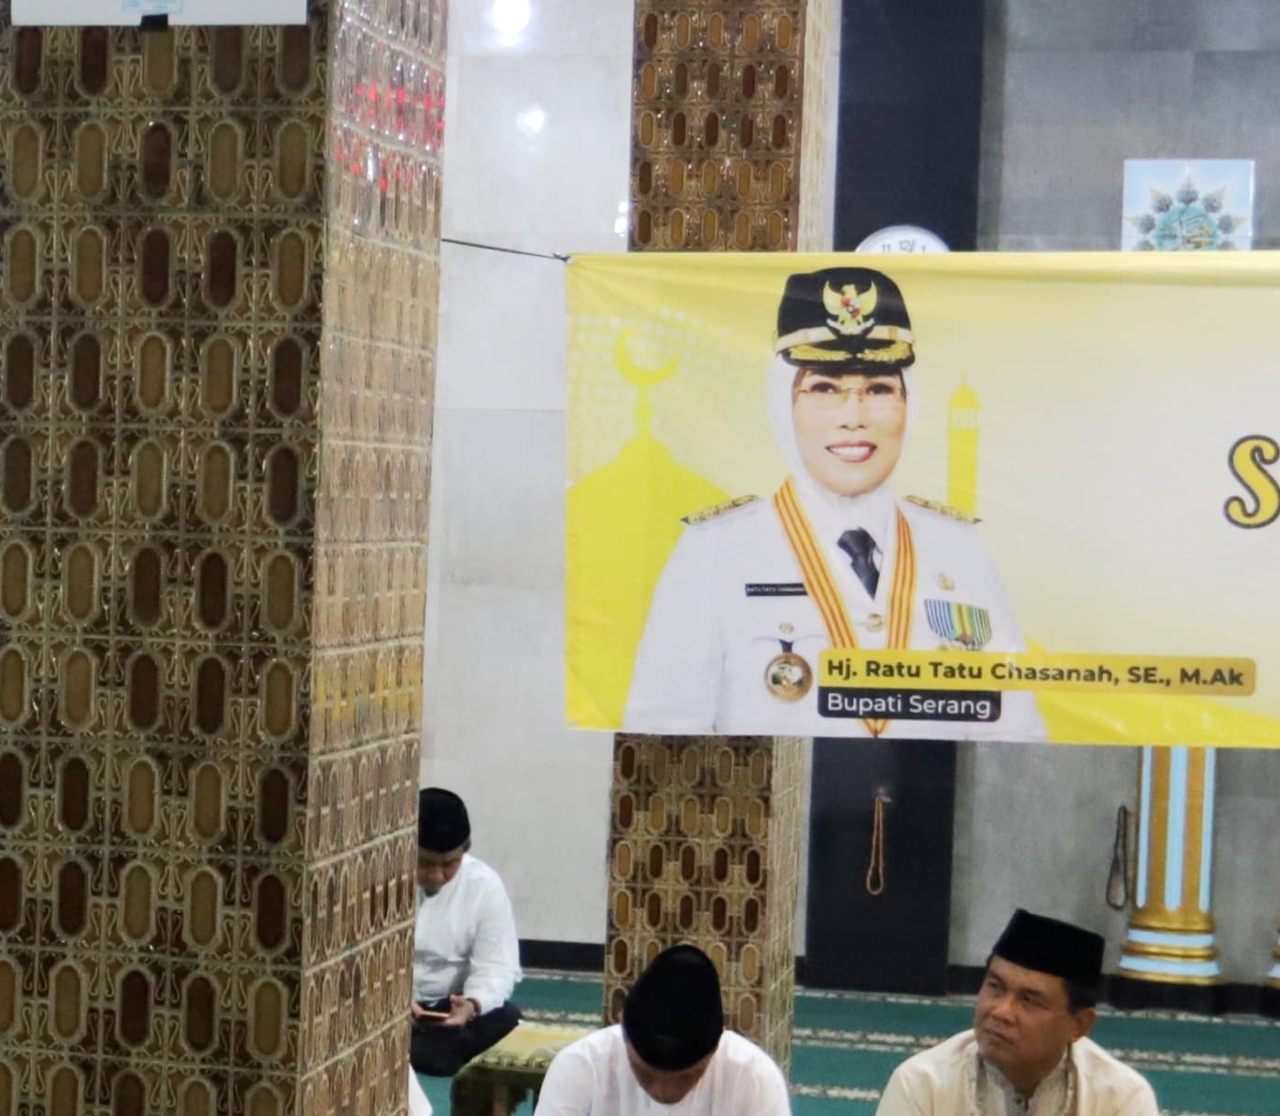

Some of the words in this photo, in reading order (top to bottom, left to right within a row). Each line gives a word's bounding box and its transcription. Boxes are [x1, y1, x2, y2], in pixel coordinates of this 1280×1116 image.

[826, 658, 857, 680] Hj.
[865, 660, 923, 680] Ratu
[929, 661, 983, 682] Tatu
[990, 660, 1120, 687] Chasanah,
[1128, 664, 1172, 687] SE.,
[1180, 665, 1244, 687] M.Ak
[826, 693, 904, 717] Bupati
[910, 694, 993, 720] Serang
